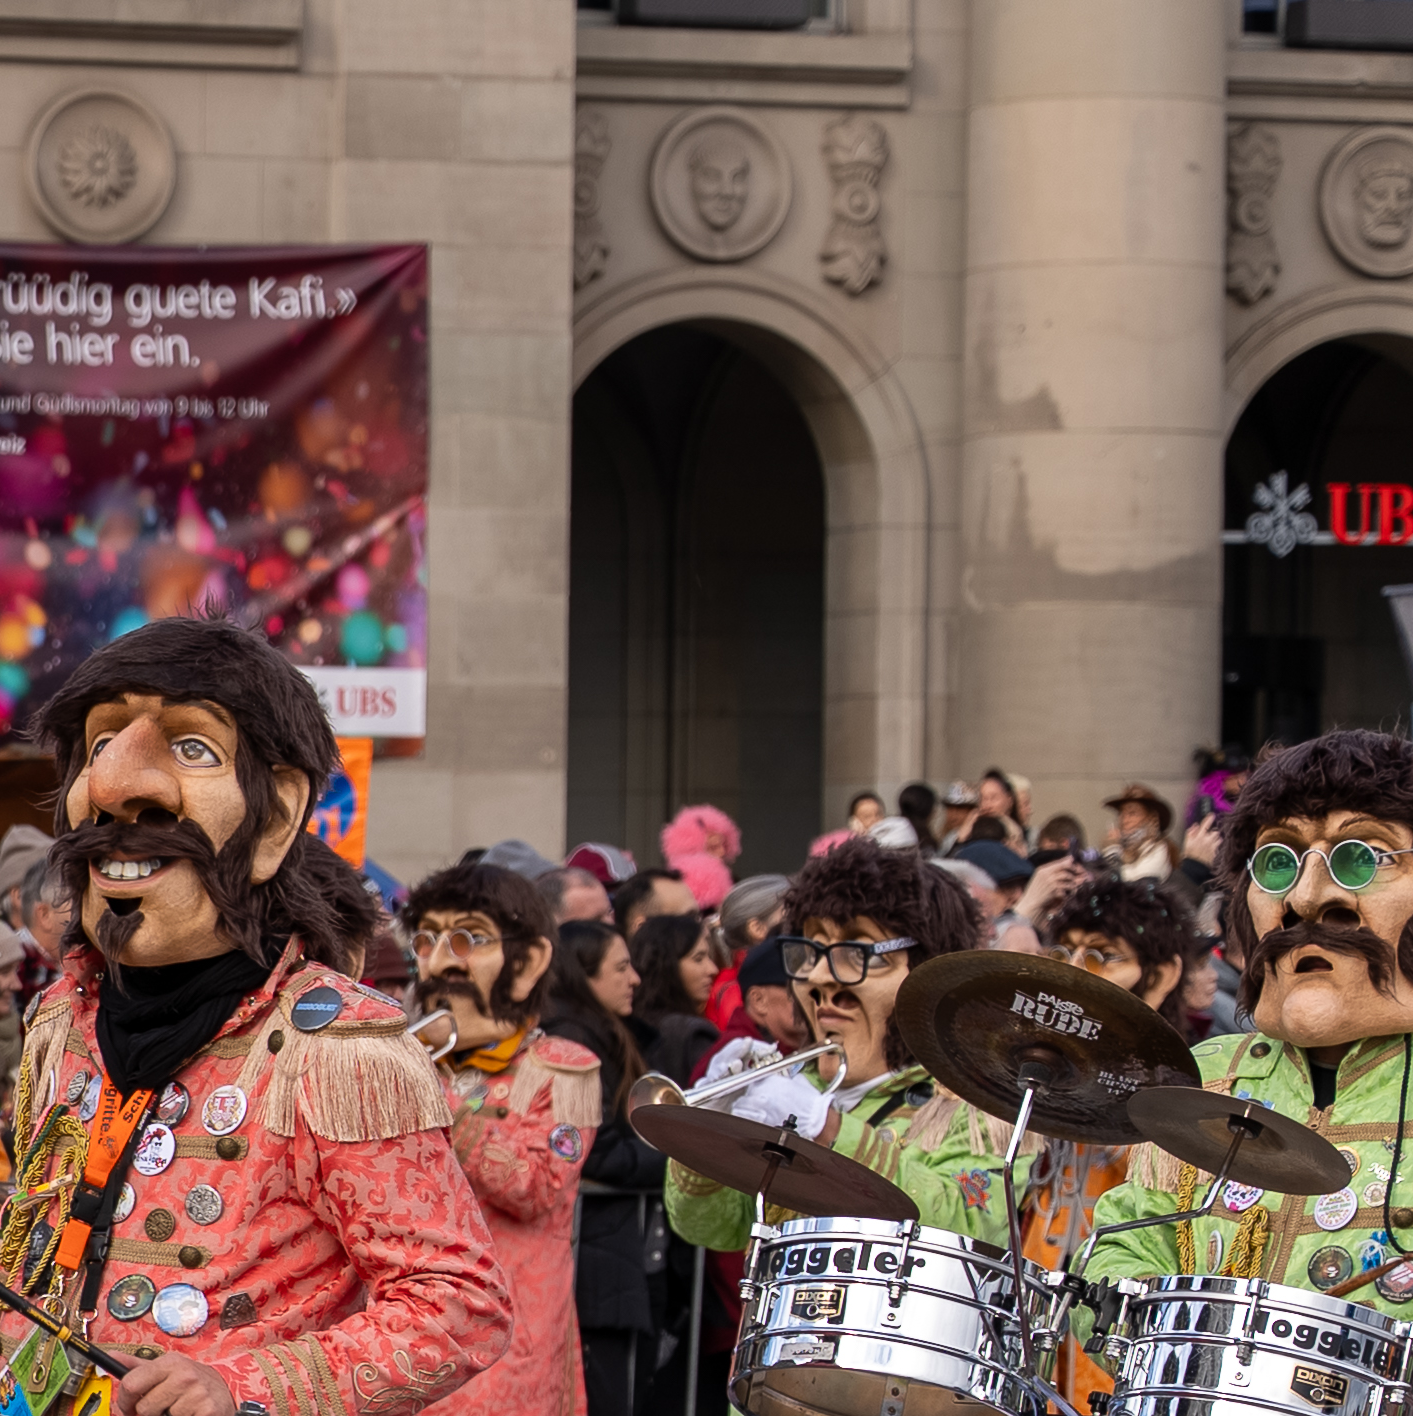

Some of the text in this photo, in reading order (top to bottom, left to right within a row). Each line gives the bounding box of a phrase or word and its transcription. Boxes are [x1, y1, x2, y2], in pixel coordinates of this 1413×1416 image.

[124, 278, 237, 328] guete
[248, 274, 358, 319] Kafi.»
[45, 320, 120, 367] hier
[130, 323, 200, 368] ein.
[337, 690, 396, 719] UBS
[1010, 993, 1102, 1040] RUDE
